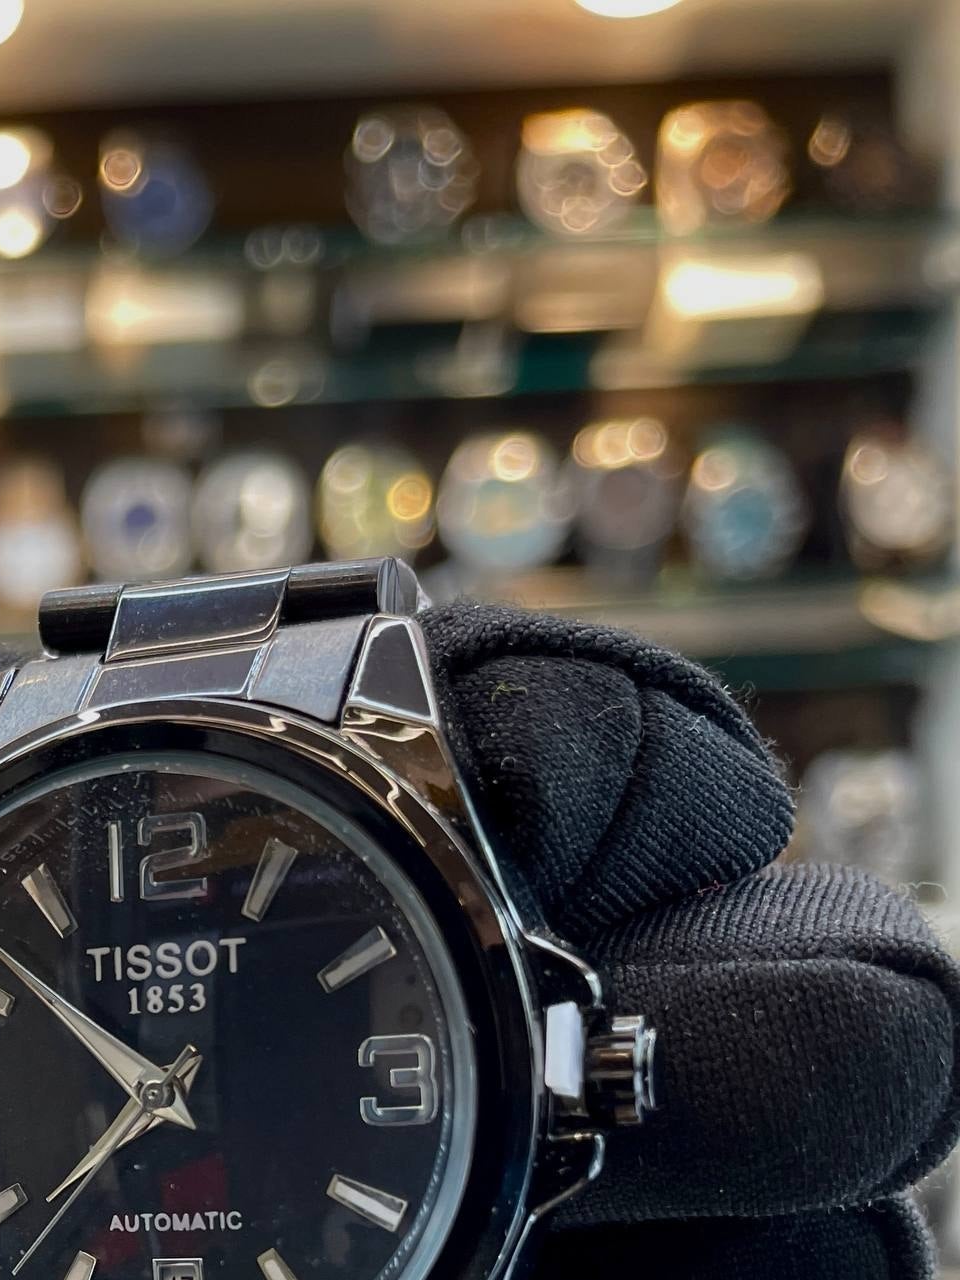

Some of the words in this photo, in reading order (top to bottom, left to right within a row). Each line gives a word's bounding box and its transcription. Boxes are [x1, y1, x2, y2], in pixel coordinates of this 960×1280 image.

[108, 811, 208, 902] 12
[86, 937, 247, 982] TISSOT
[127, 983, 206, 1015] 1853
[357, 1033, 438, 1126] 3
[109, 1211, 243, 1233] AUTOMATIC
